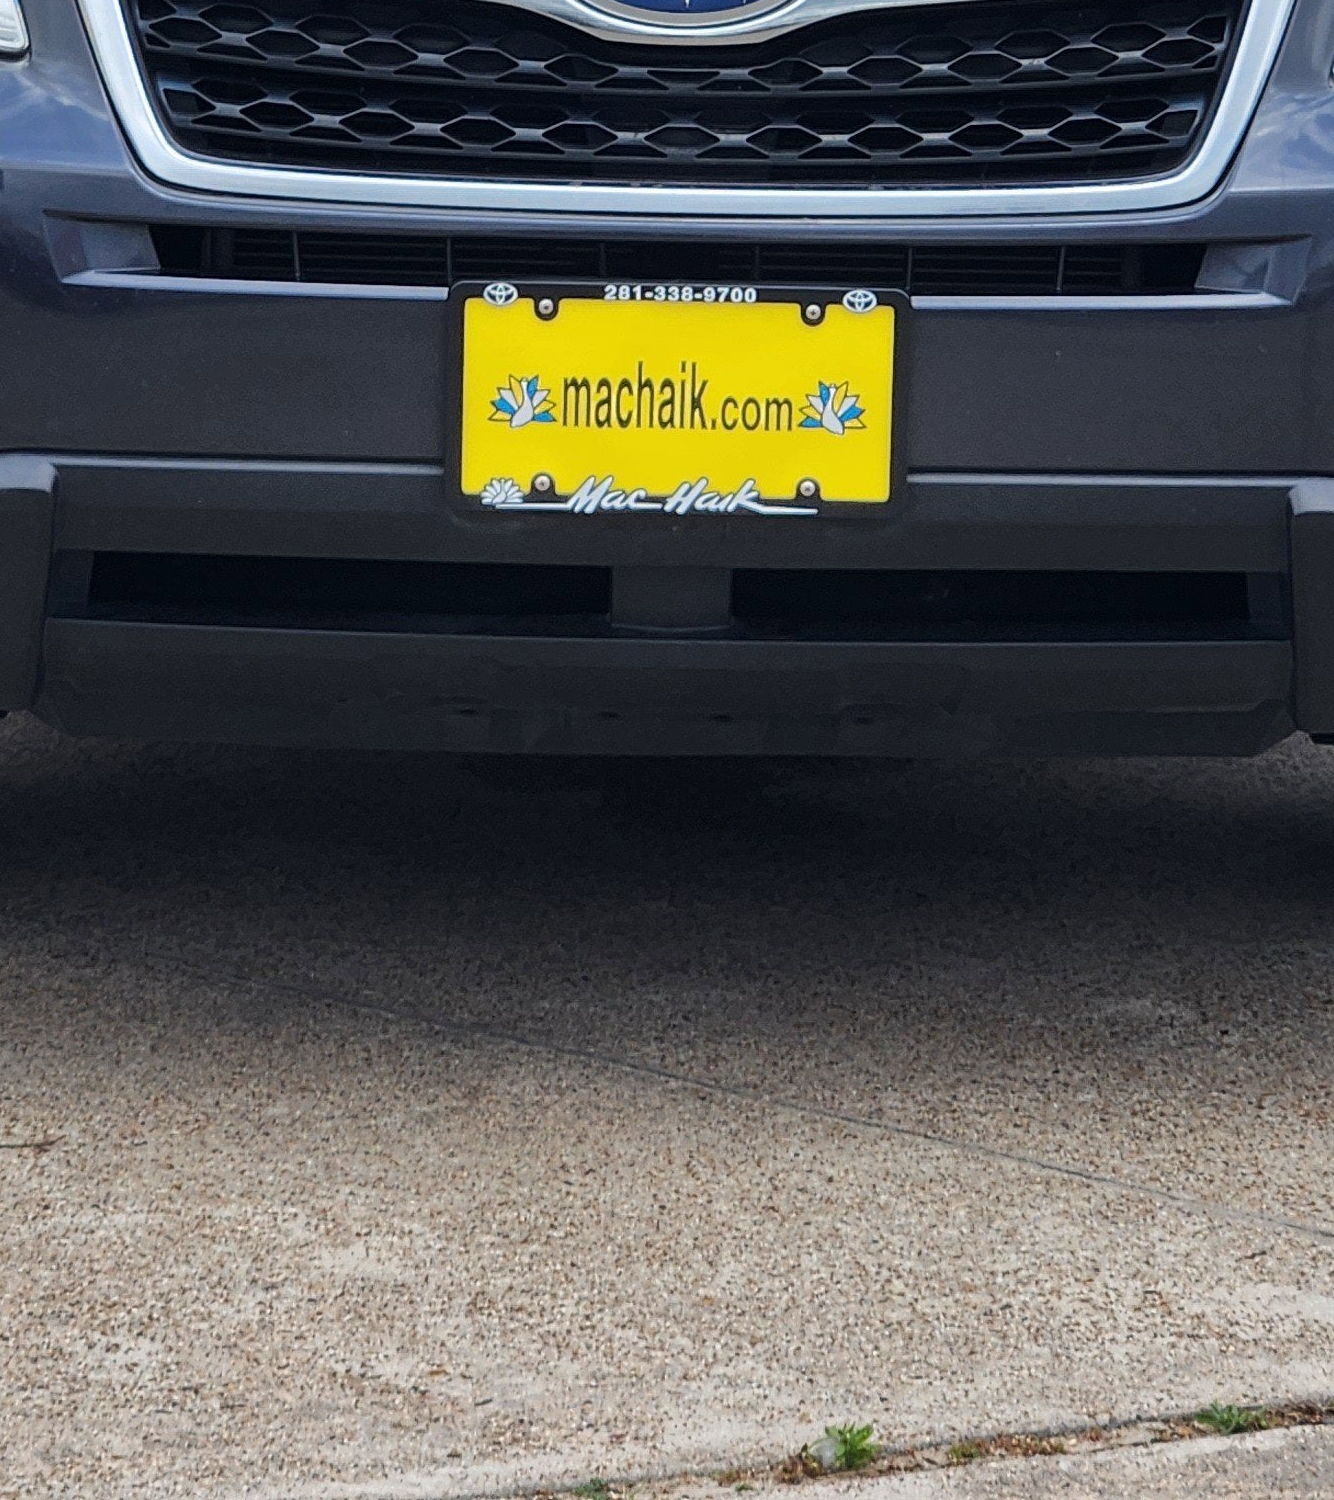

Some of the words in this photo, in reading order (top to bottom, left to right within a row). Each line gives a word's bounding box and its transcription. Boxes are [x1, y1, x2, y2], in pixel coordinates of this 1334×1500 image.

[603, 284, 758, 303] 281-338-9700
[561, 360, 794, 432] machaik.com
[566, 474, 659, 515] Mac
[663, 476, 762, 516] Haik
